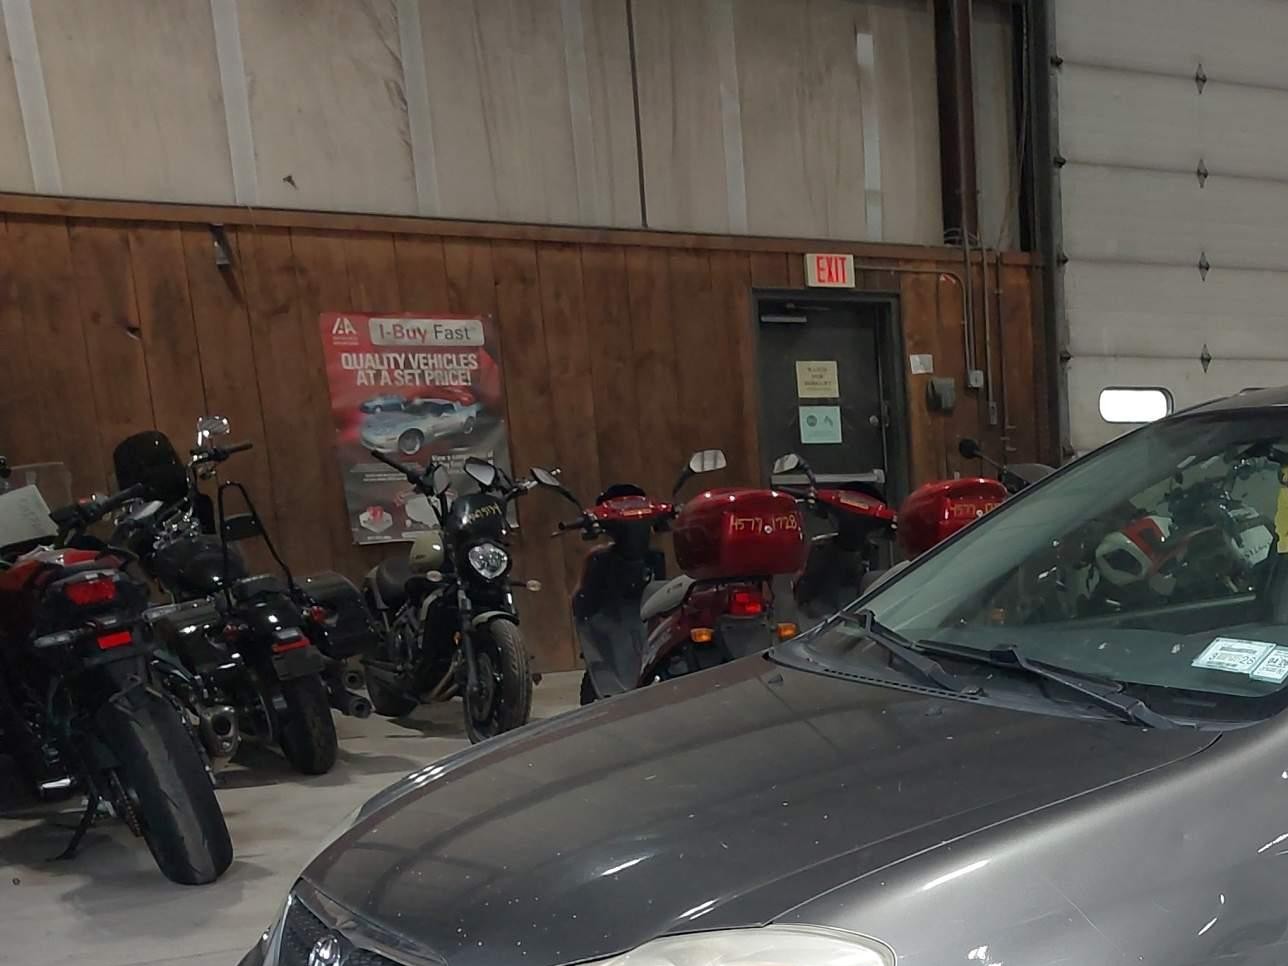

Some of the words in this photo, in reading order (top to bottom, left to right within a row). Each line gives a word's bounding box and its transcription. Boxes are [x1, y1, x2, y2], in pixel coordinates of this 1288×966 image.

[816, 255, 847, 284] EXIT
[379, 324, 427, 342] I-Buy
[433, 324, 471, 340] Fast
[341, 353, 405, 370] QUALITY
[408, 353, 478, 370] VEHICLES
[357, 370, 377, 387] AT
[380, 370, 392, 387] A
[394, 370, 421, 387] SET
[425, 371, 472, 387] PRICE!
